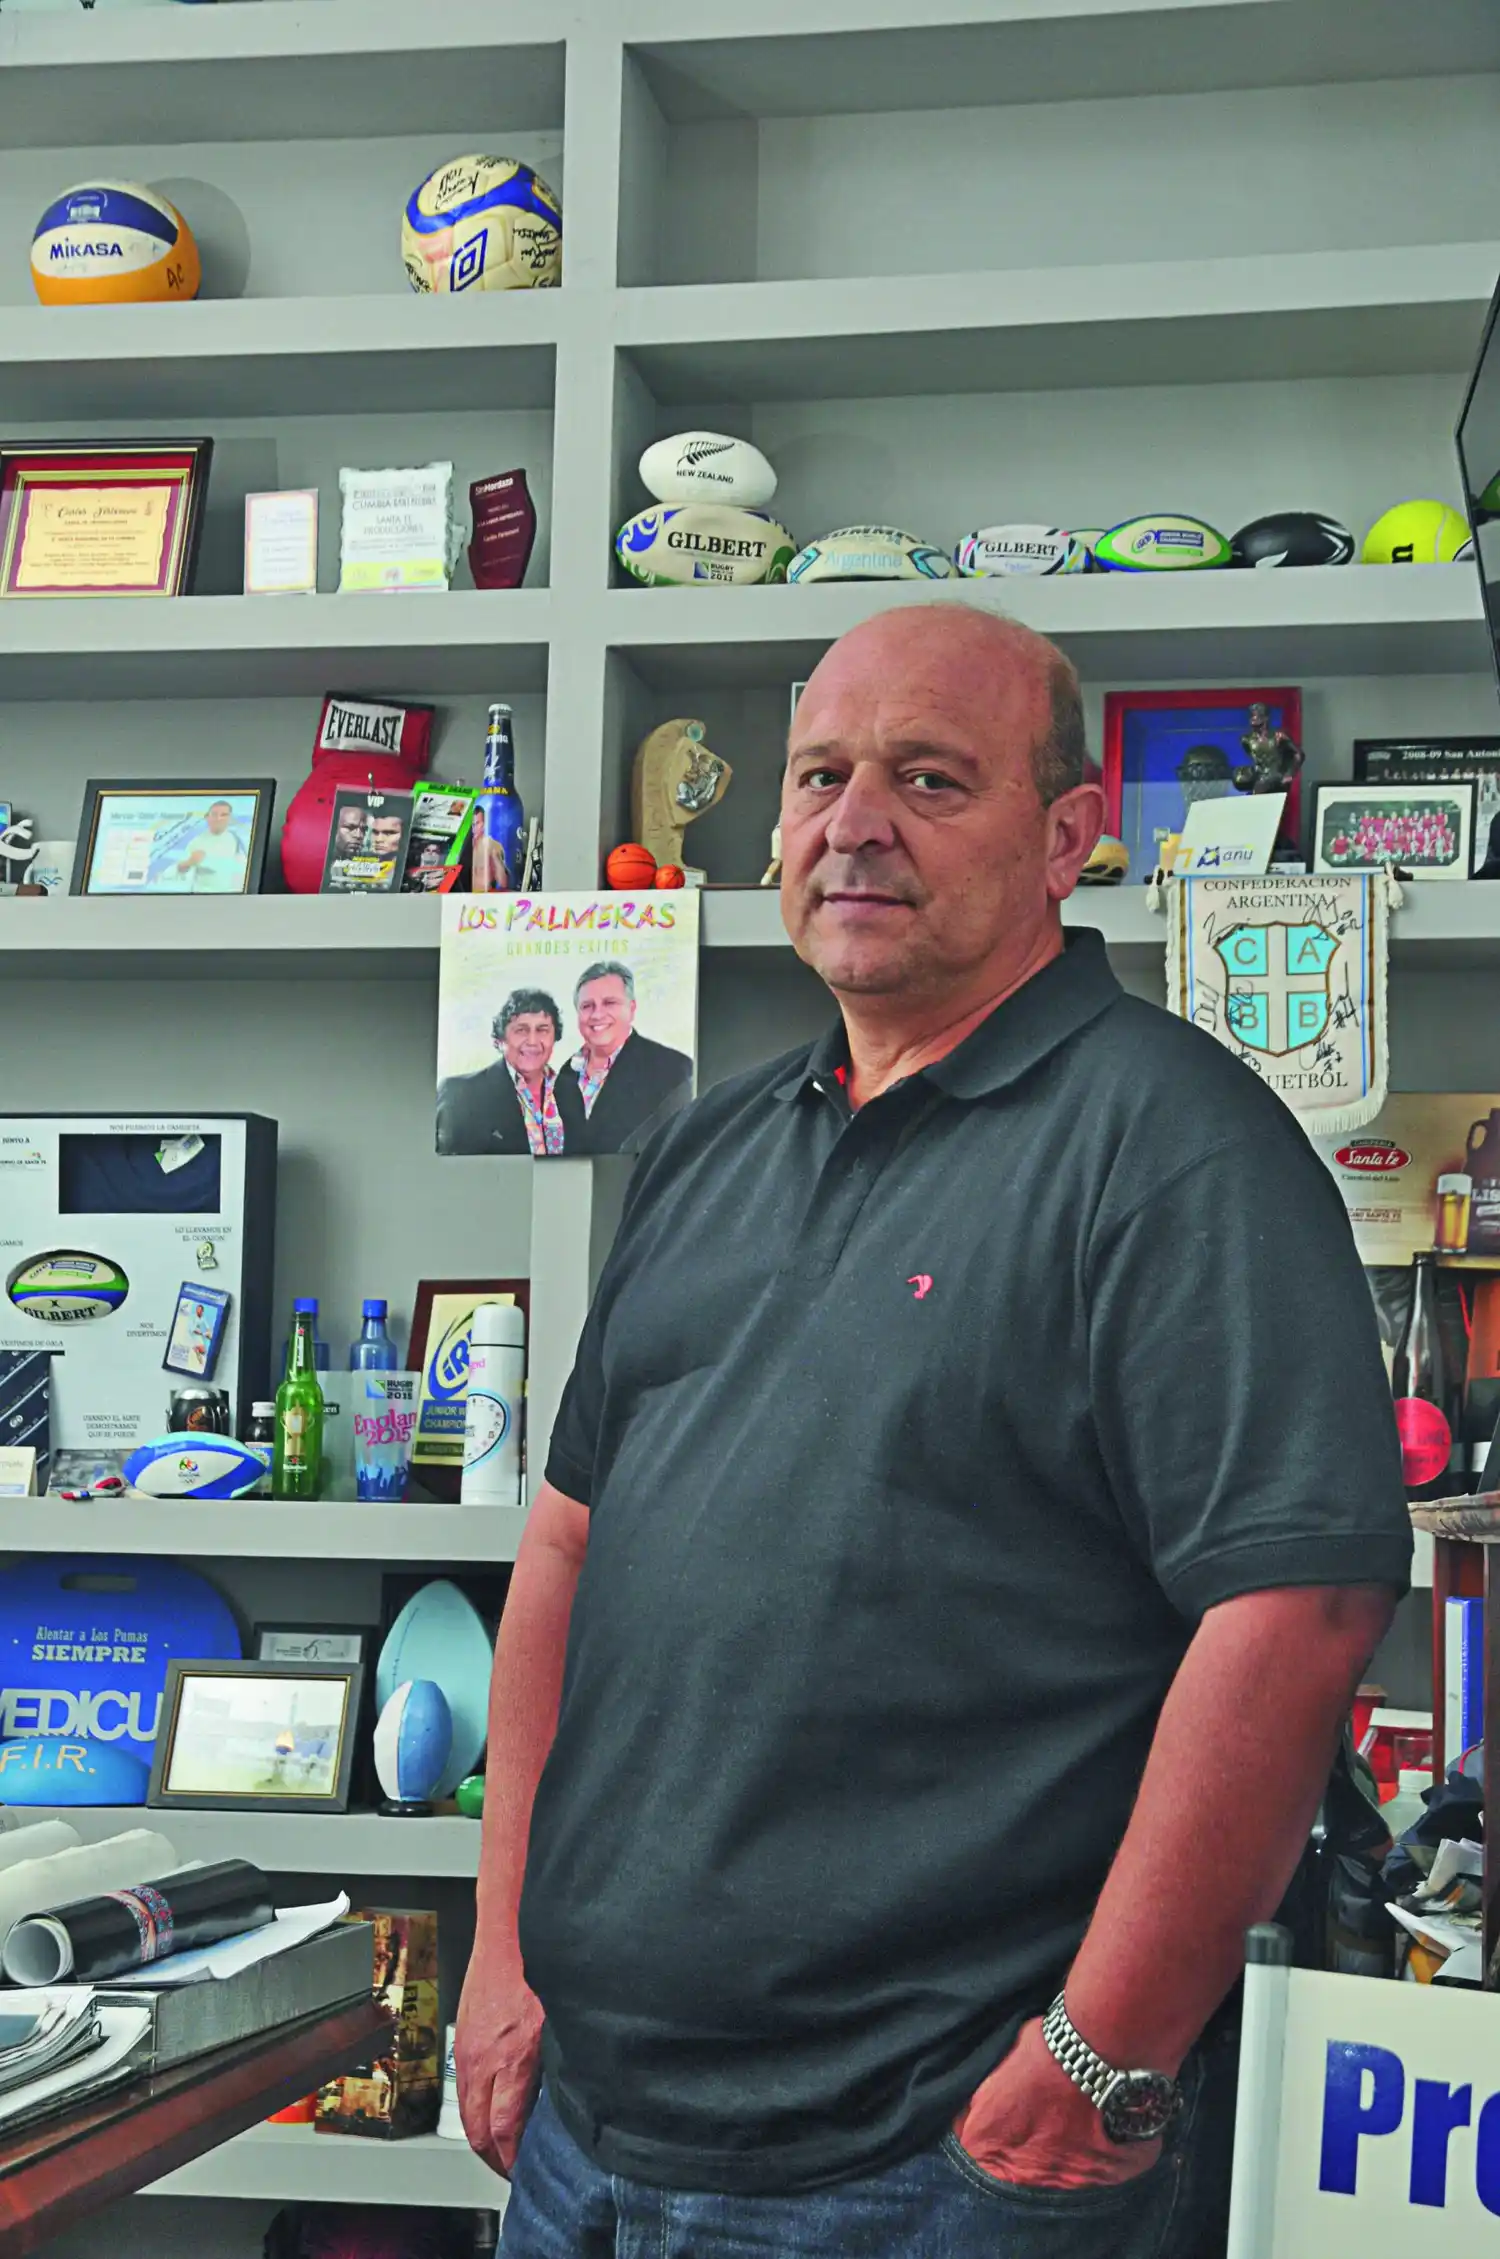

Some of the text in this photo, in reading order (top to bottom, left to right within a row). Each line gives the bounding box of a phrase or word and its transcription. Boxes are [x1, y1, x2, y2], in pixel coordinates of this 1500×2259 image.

[50, 237, 123, 260] MIKASA
[698, 470, 734, 484] ZEALAND
[668, 531, 766, 557] GILBERT
[985, 542, 1058, 556] GILBERT
[711, 563, 734, 571] RUGBY
[711, 573, 733, 582] 2011
[325, 705, 401, 750] EVERLAST
[367, 796, 384, 807] VIP
[1203, 878, 1352, 891] CONFEDERACION
[1226, 893, 1329, 909] ARGENTINA
[458, 899, 677, 933] LOS PALMERAS
[507, 939, 630, 956] GRANDES EXITOS
[1234, 937, 1321, 965] C A
[1239, 1002, 1320, 1029] B B
[1266, 1071, 1349, 1090] UETBOL
[1344, 1148, 1400, 1165] Santa Fe
[23, 1305, 96, 1321] GILBERT
[354, 1408, 417, 1435] Englan
[367, 1427, 411, 1448] 2015
[36, 1626, 149, 1642] Alentar a Los Pumas
[32, 1644, 147, 1663] SIEMPRE
